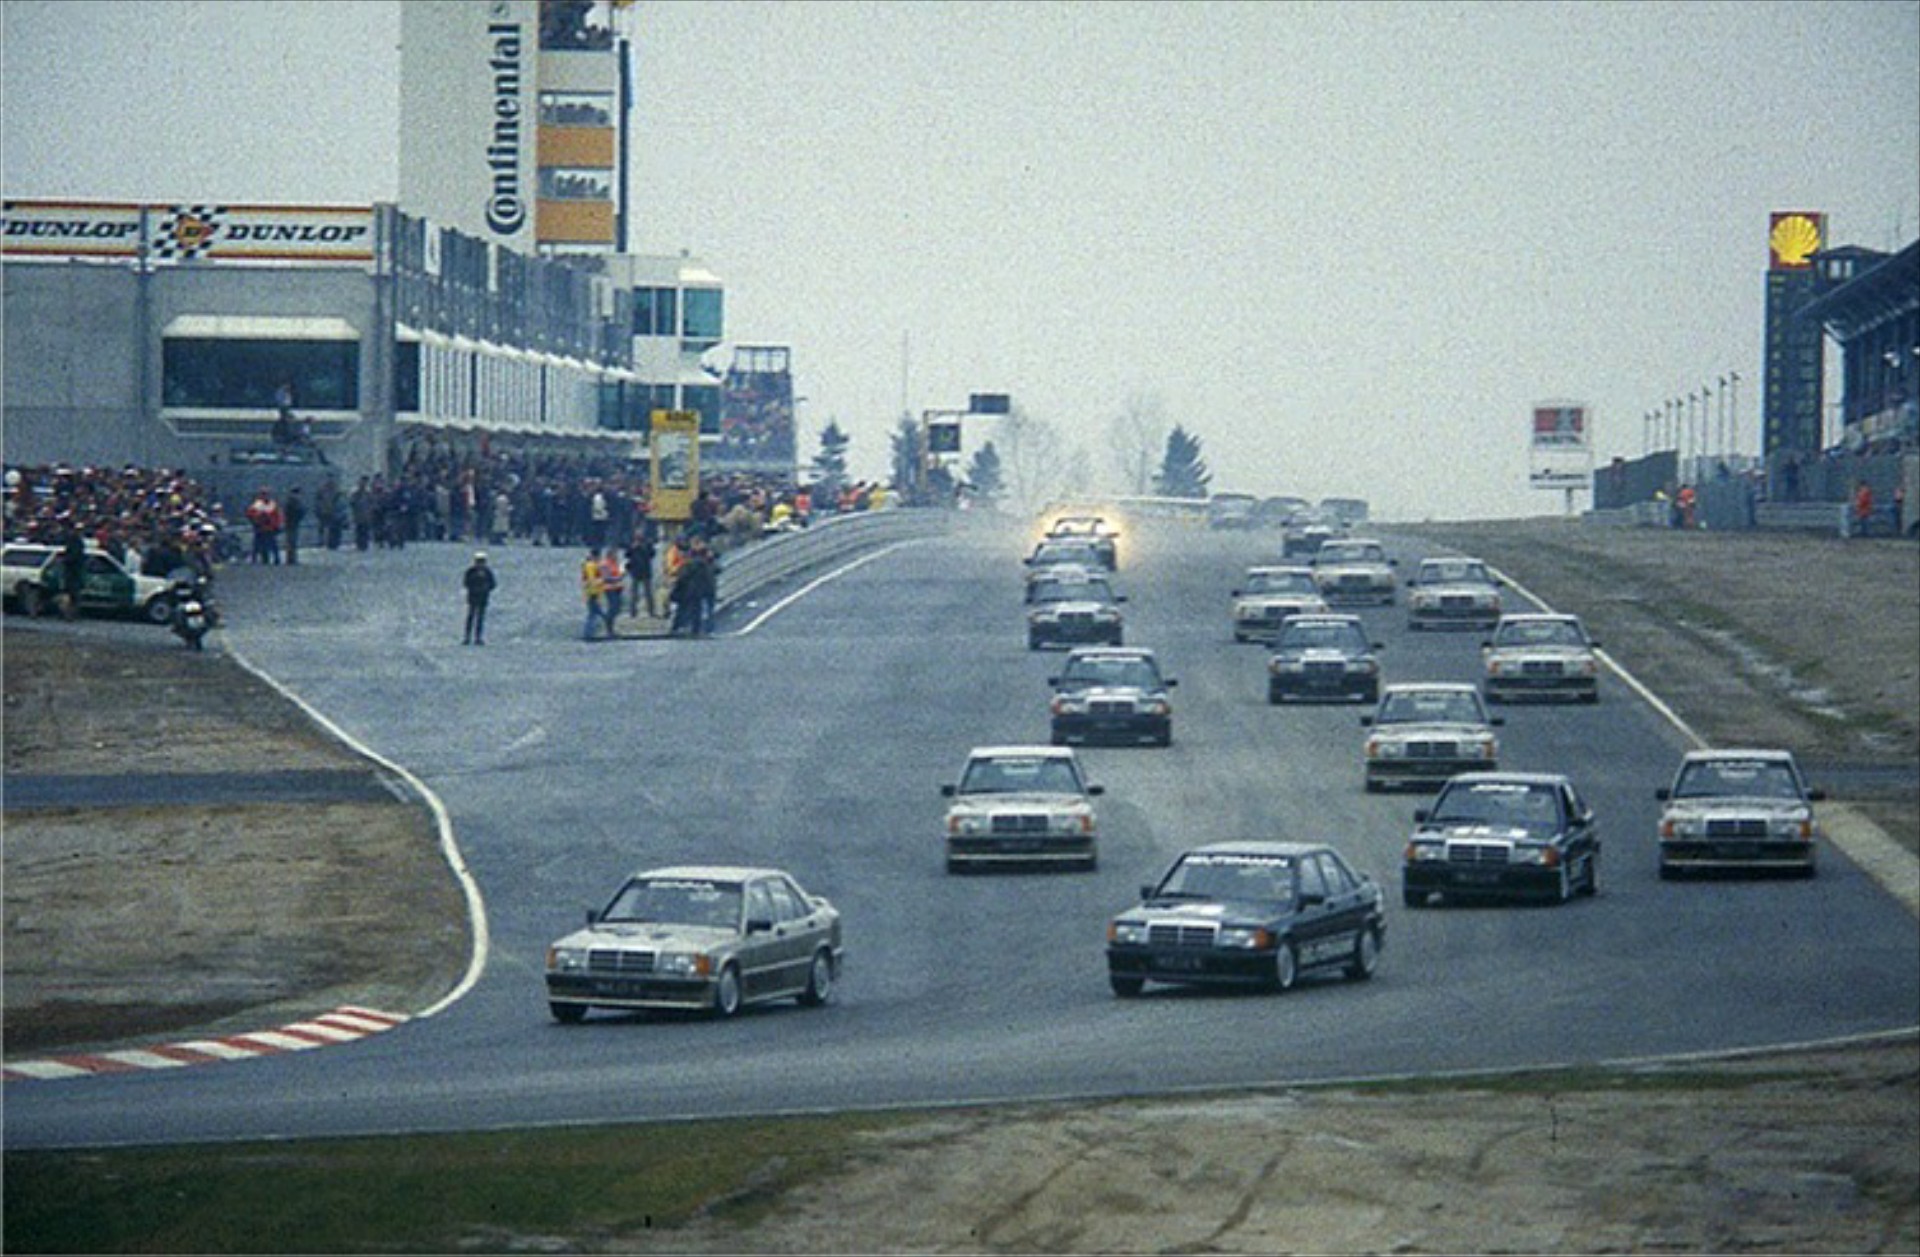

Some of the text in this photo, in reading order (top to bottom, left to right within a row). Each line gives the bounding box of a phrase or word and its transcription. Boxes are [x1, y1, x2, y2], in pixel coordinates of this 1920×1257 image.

[485, 23, 525, 235] Continental
[4, 221, 139, 238] DUNLOP
[224, 223, 367, 241] DUNLOP
